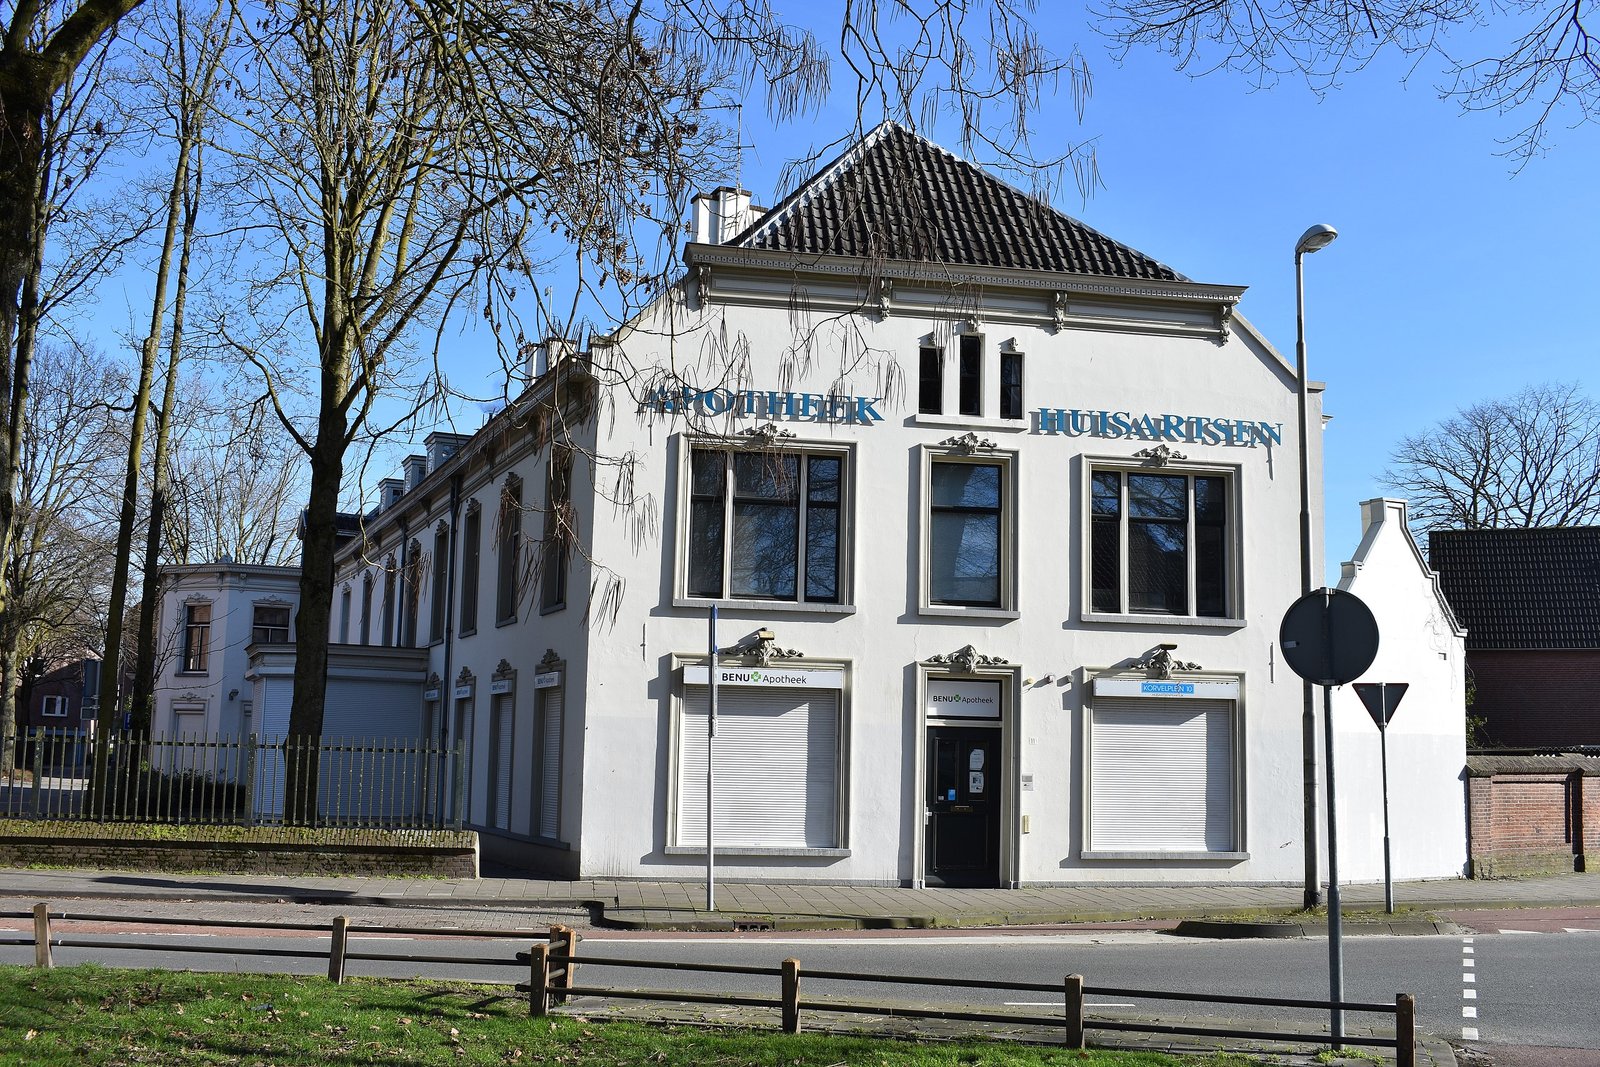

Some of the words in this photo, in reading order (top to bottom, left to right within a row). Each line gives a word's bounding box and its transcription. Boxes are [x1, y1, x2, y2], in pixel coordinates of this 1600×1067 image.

[1037, 407, 1283, 446] HUISARTSEN
[721, 672, 750, 682] BENU
[762, 674, 807, 685] Apotheek
[1143, 684, 1184, 692] KORVELPLEIN
[962, 696, 994, 704] Apotheek
